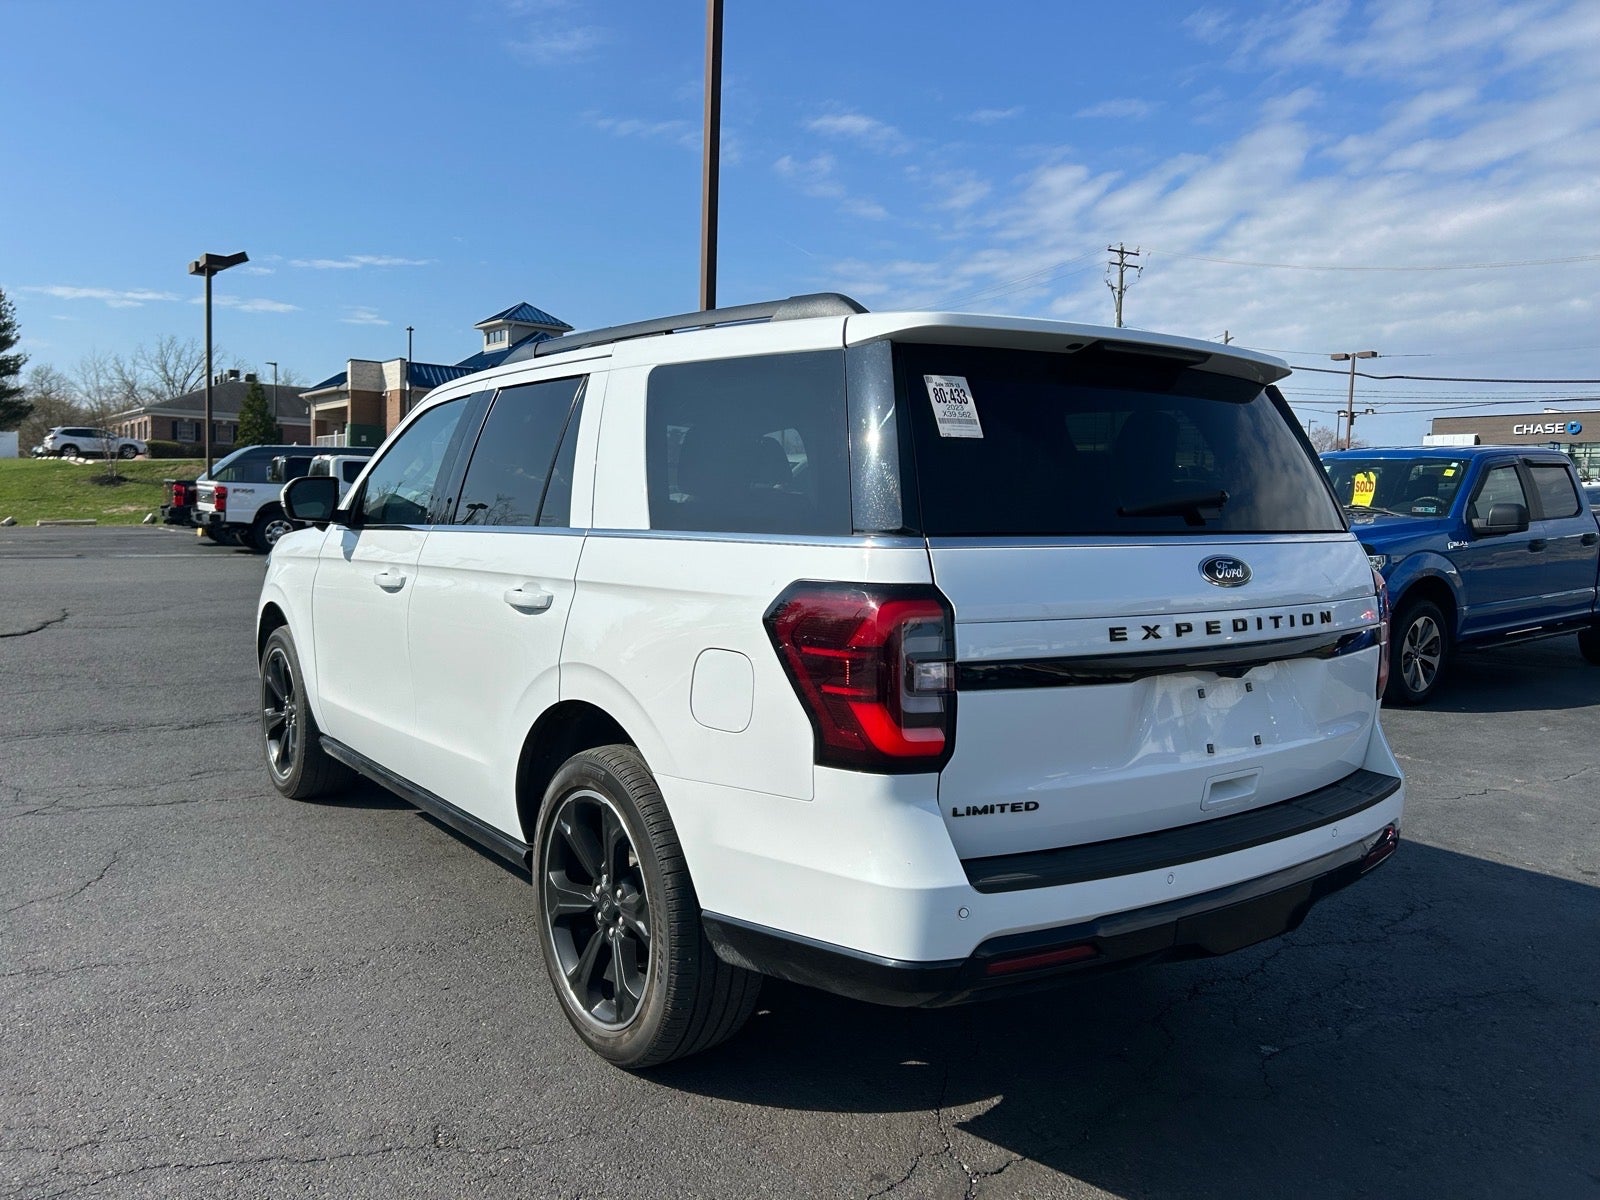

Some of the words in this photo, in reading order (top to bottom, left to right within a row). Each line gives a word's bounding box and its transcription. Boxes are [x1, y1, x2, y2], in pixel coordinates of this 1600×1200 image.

[933, 387, 968, 404] 80:433
[1513, 422, 1565, 435] CHASE
[1355, 480, 1374, 493] SOLD
[1216, 560, 1244, 579] Ford
[1109, 610, 1332, 642] EXPEDITION
[952, 801, 1040, 817] LIMITED
